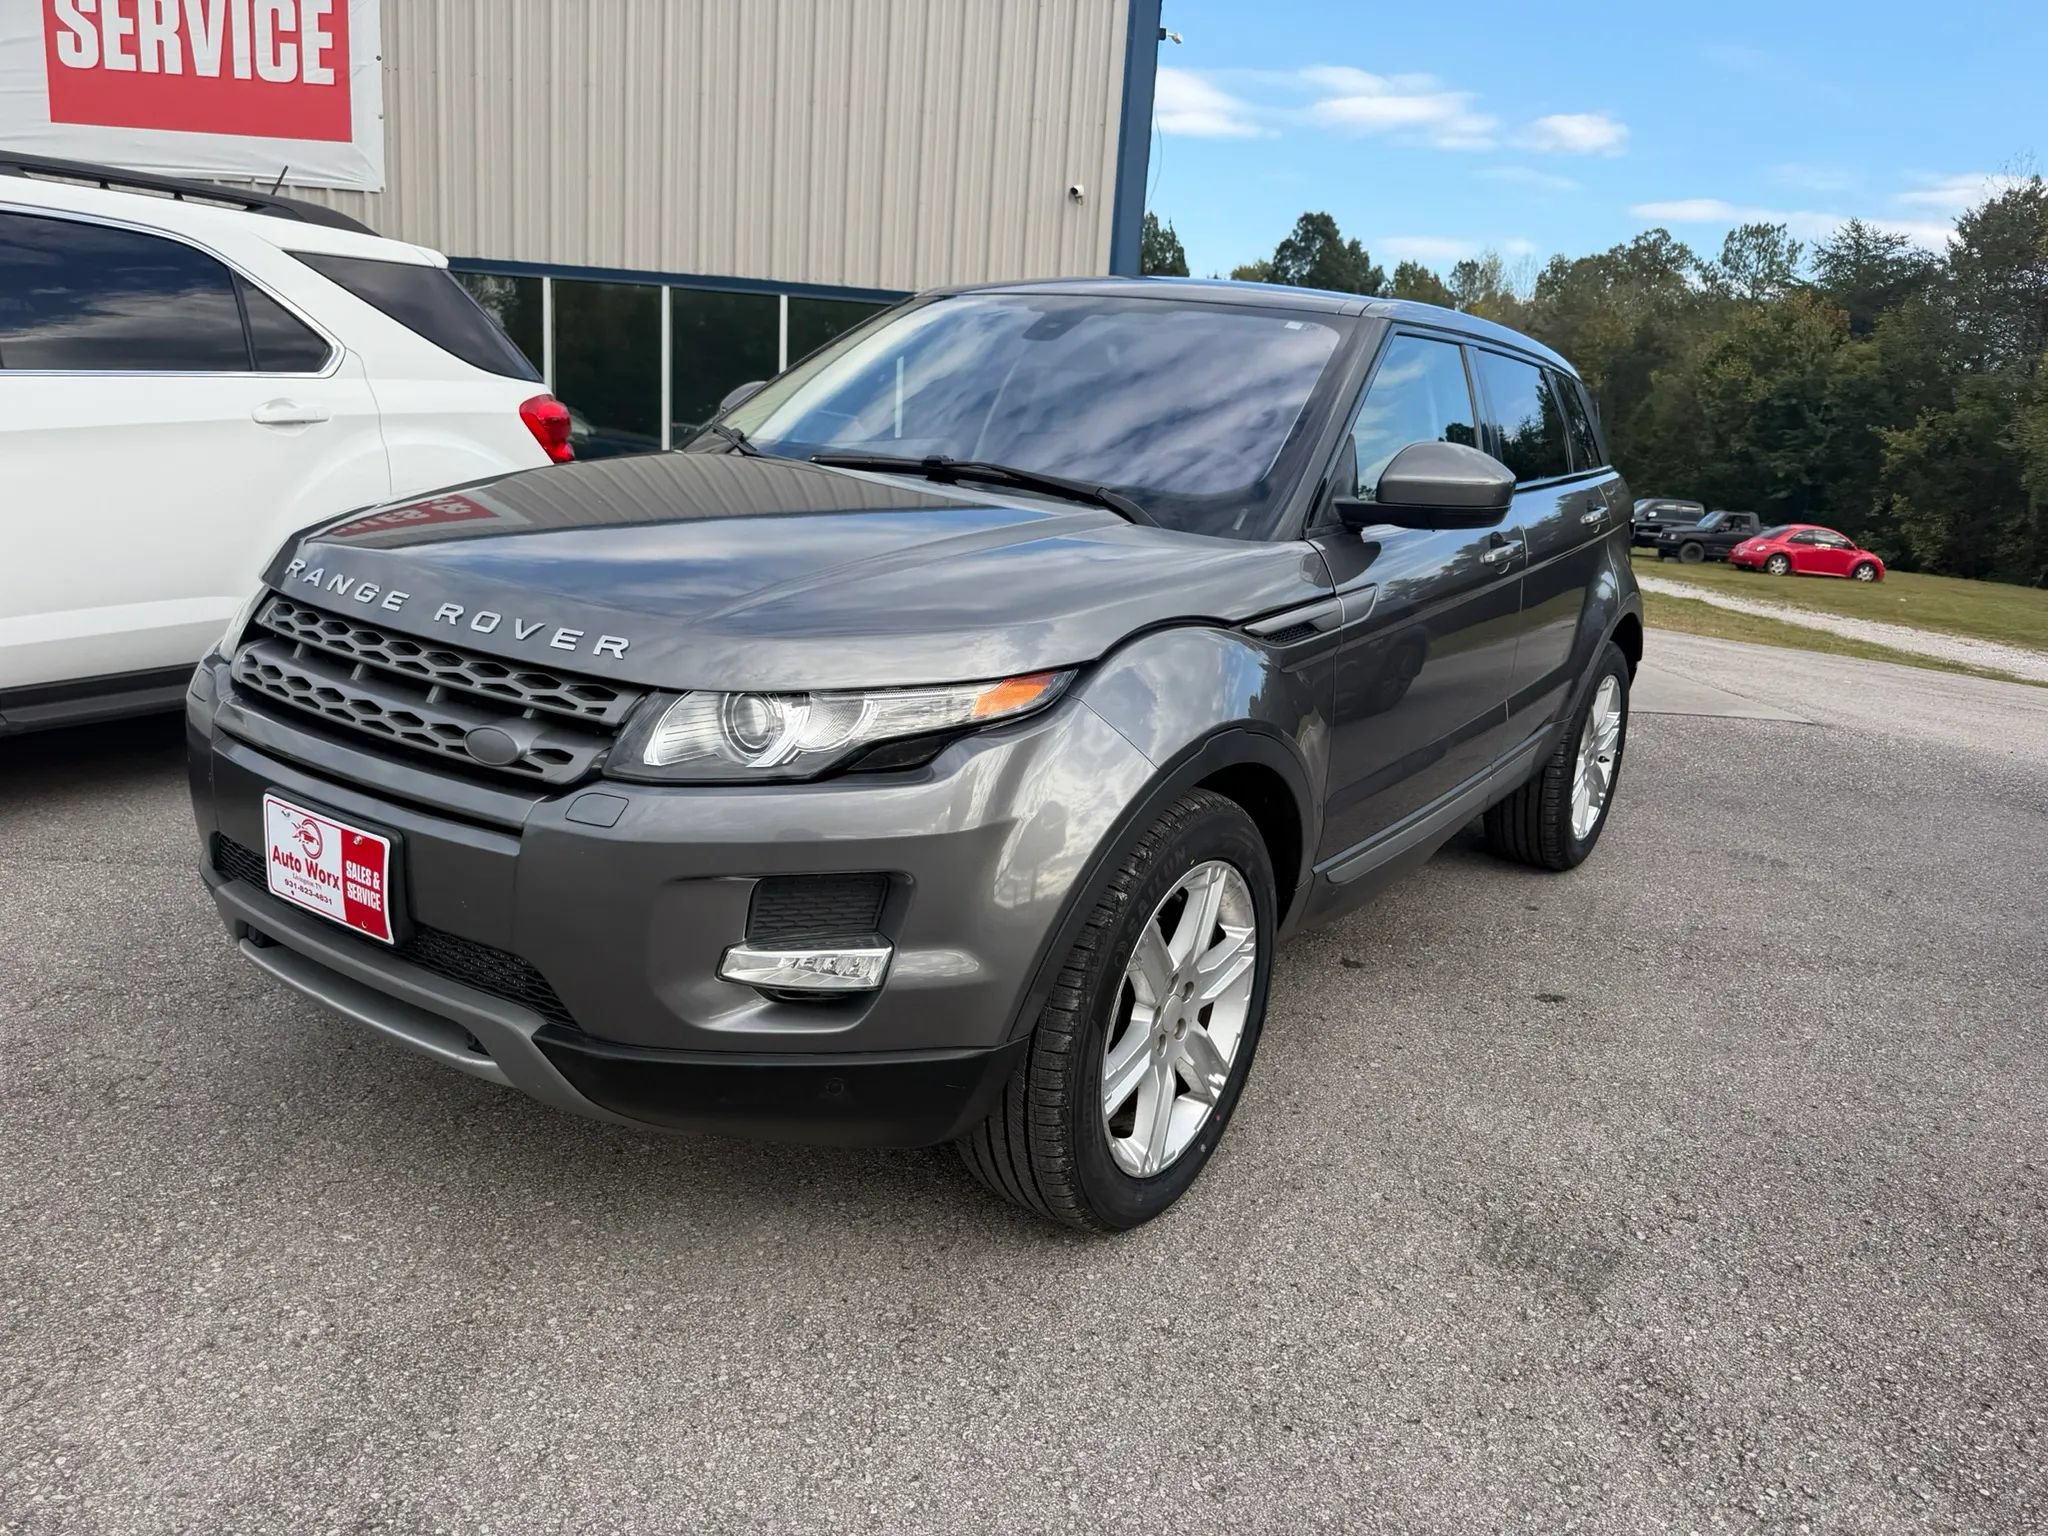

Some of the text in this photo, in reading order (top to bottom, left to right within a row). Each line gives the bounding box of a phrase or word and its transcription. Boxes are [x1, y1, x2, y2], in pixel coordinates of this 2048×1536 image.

[56, 0, 336, 85] SERVICE
[285, 558, 631, 660] RANGE ROVER
[272, 845, 302, 872] Auto
[305, 857, 341, 891] Worx
[346, 860, 381, 890] SALES &
[346, 880, 382, 911] SERVICE
